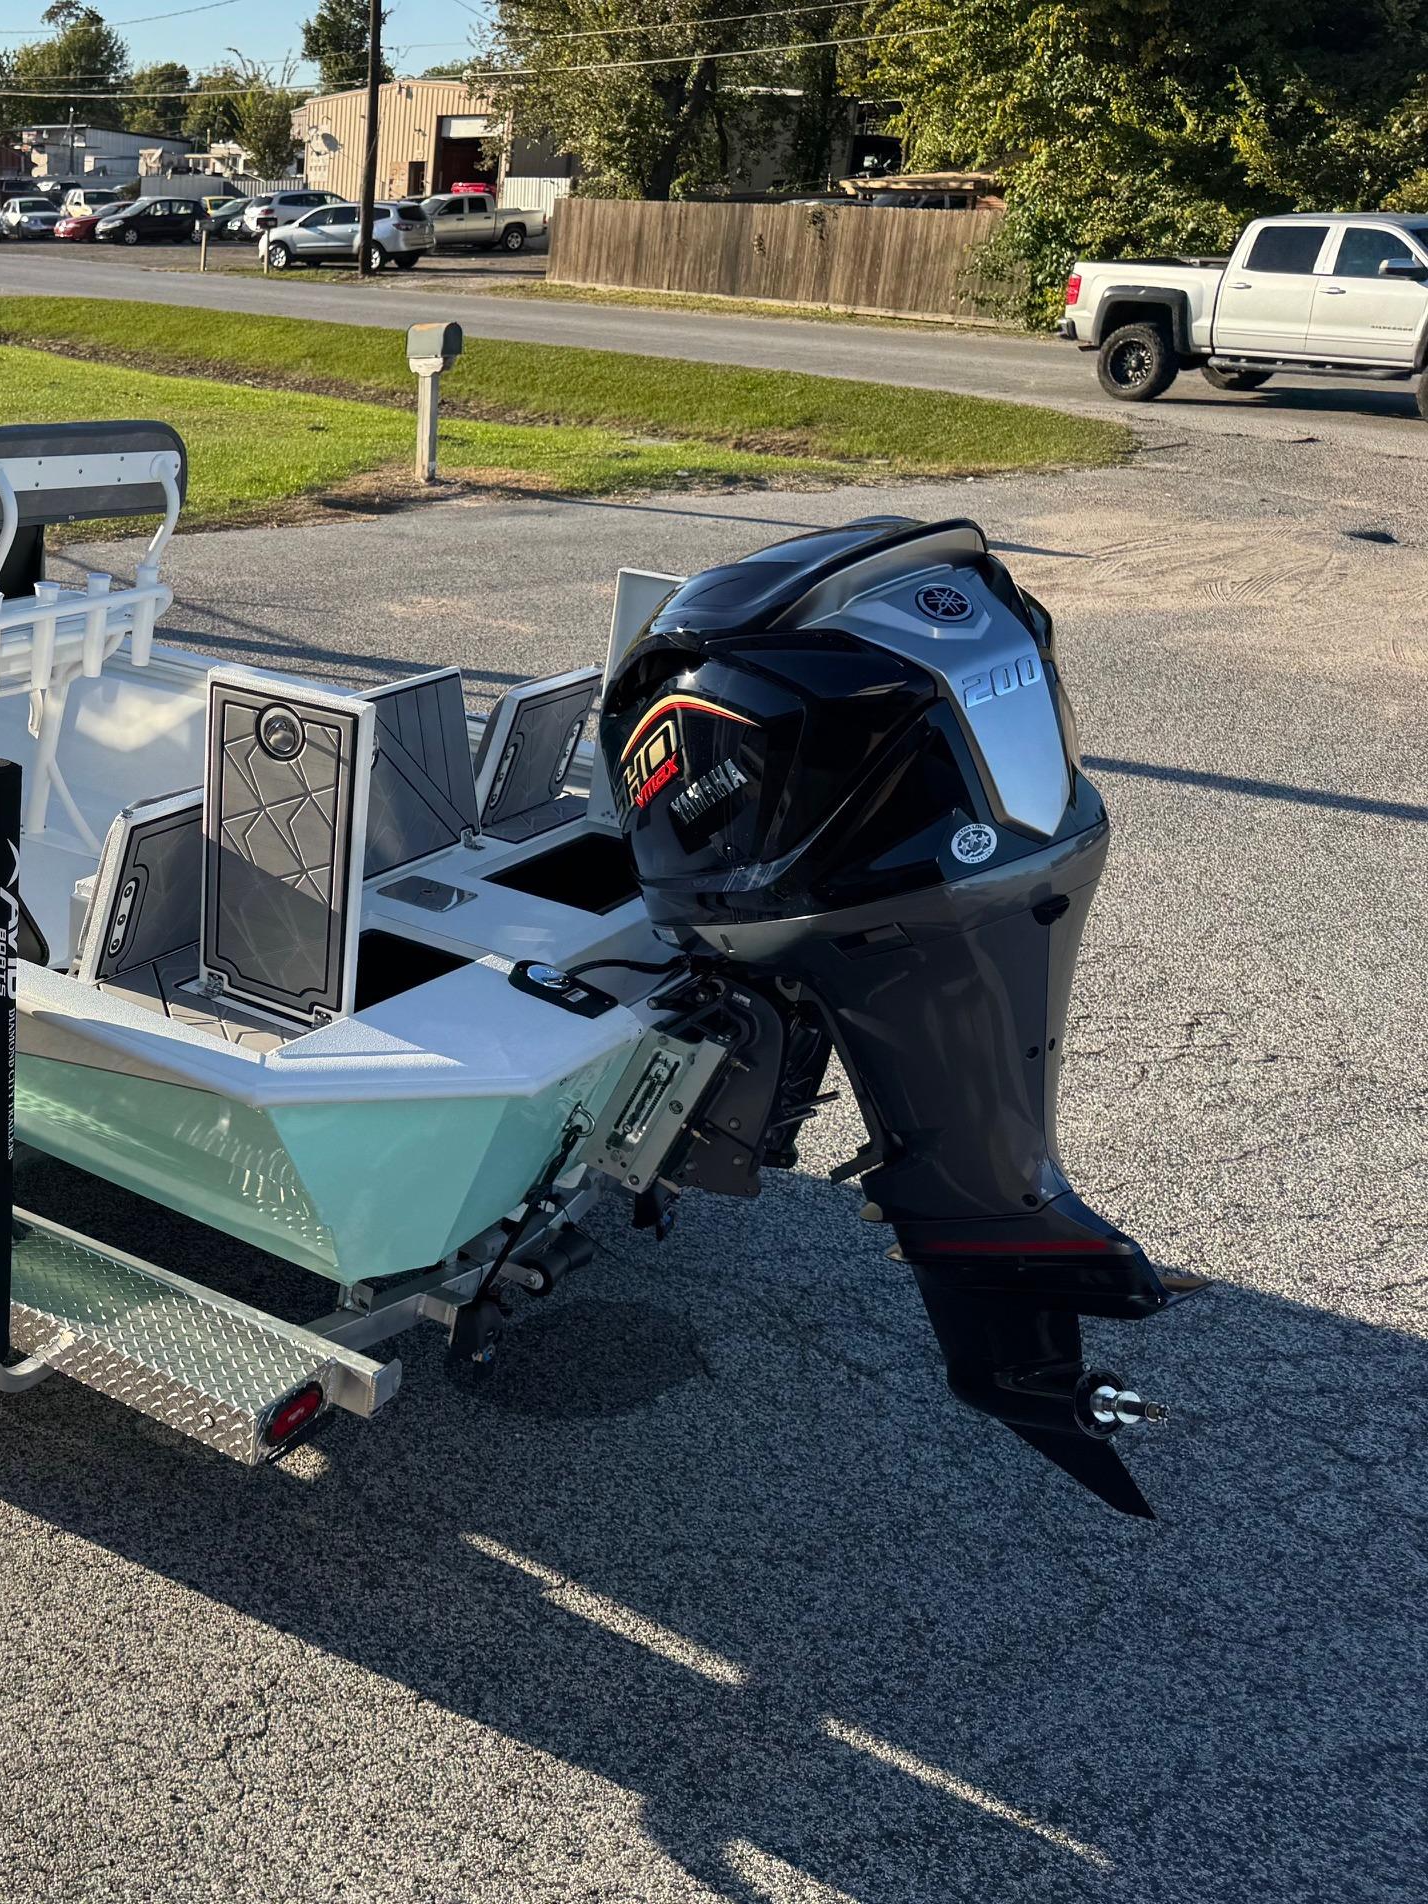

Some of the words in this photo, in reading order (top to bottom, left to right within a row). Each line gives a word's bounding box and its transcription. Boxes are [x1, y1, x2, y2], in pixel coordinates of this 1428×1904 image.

[961, 654, 1042, 710] 200
[670, 758, 749, 826] YAMAHA
[0, 886, 19, 1000] AVID
[8, 1008, 16, 1067] DIAMOND
